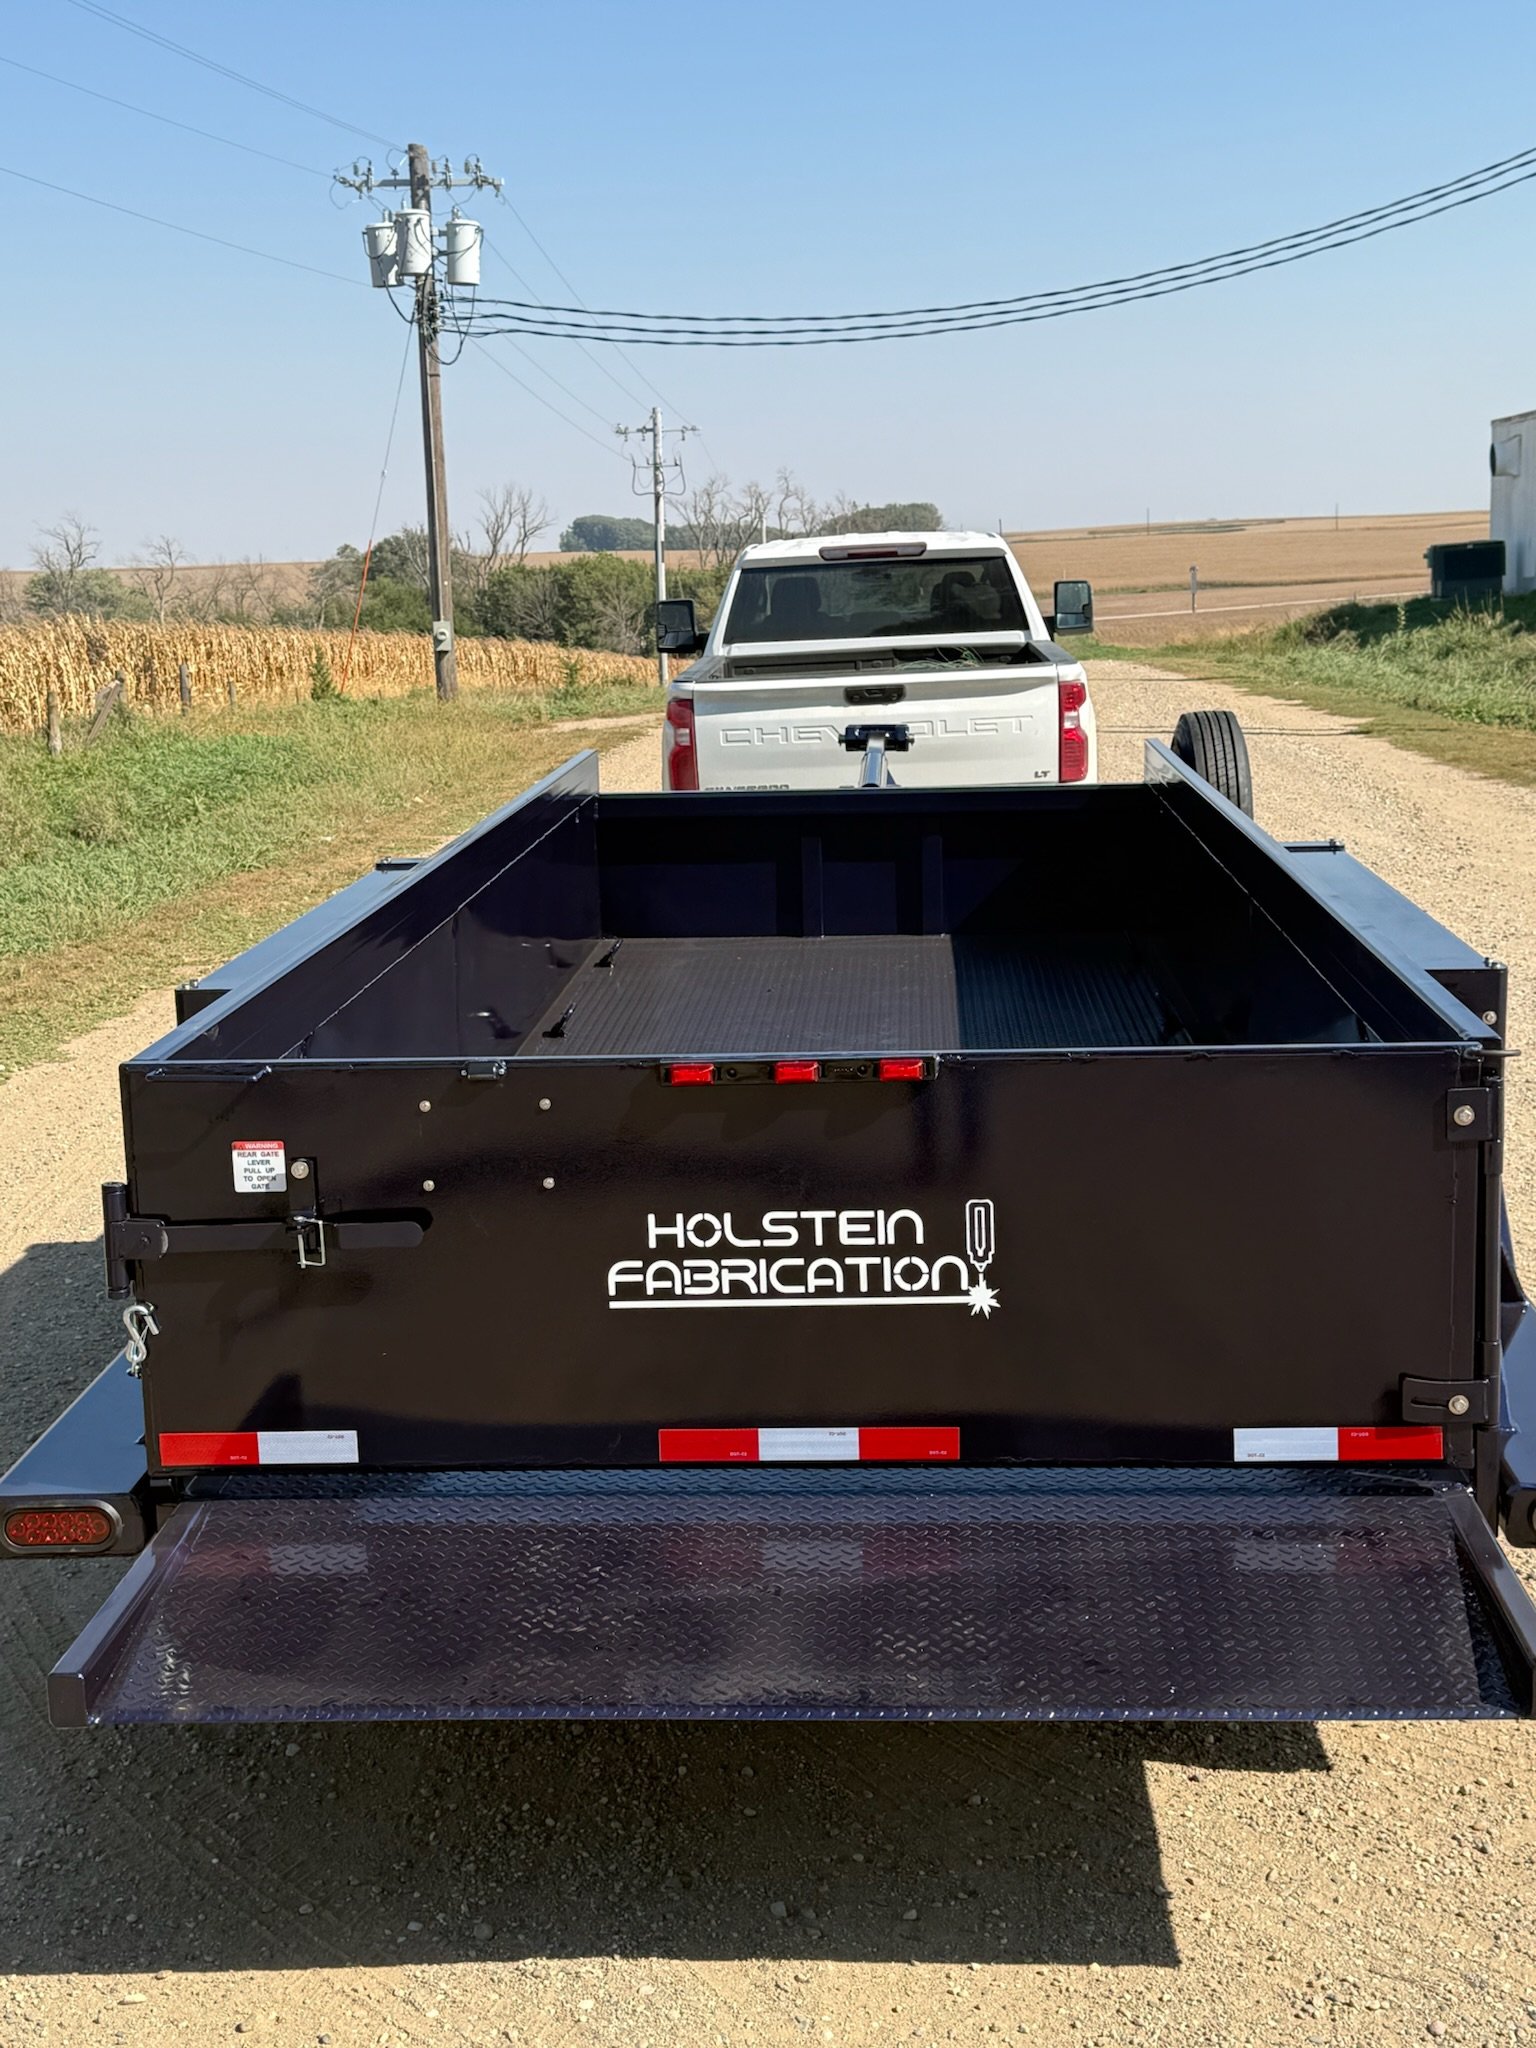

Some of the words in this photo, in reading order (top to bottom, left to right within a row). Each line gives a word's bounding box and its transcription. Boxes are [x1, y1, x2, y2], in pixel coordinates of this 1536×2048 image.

[719, 715, 1033, 746] CHEOLET
[1034, 770, 1050, 778] LT
[647, 1209, 925, 1249] HOLSTEIN
[607, 1255, 970, 1297] FABRICATION
